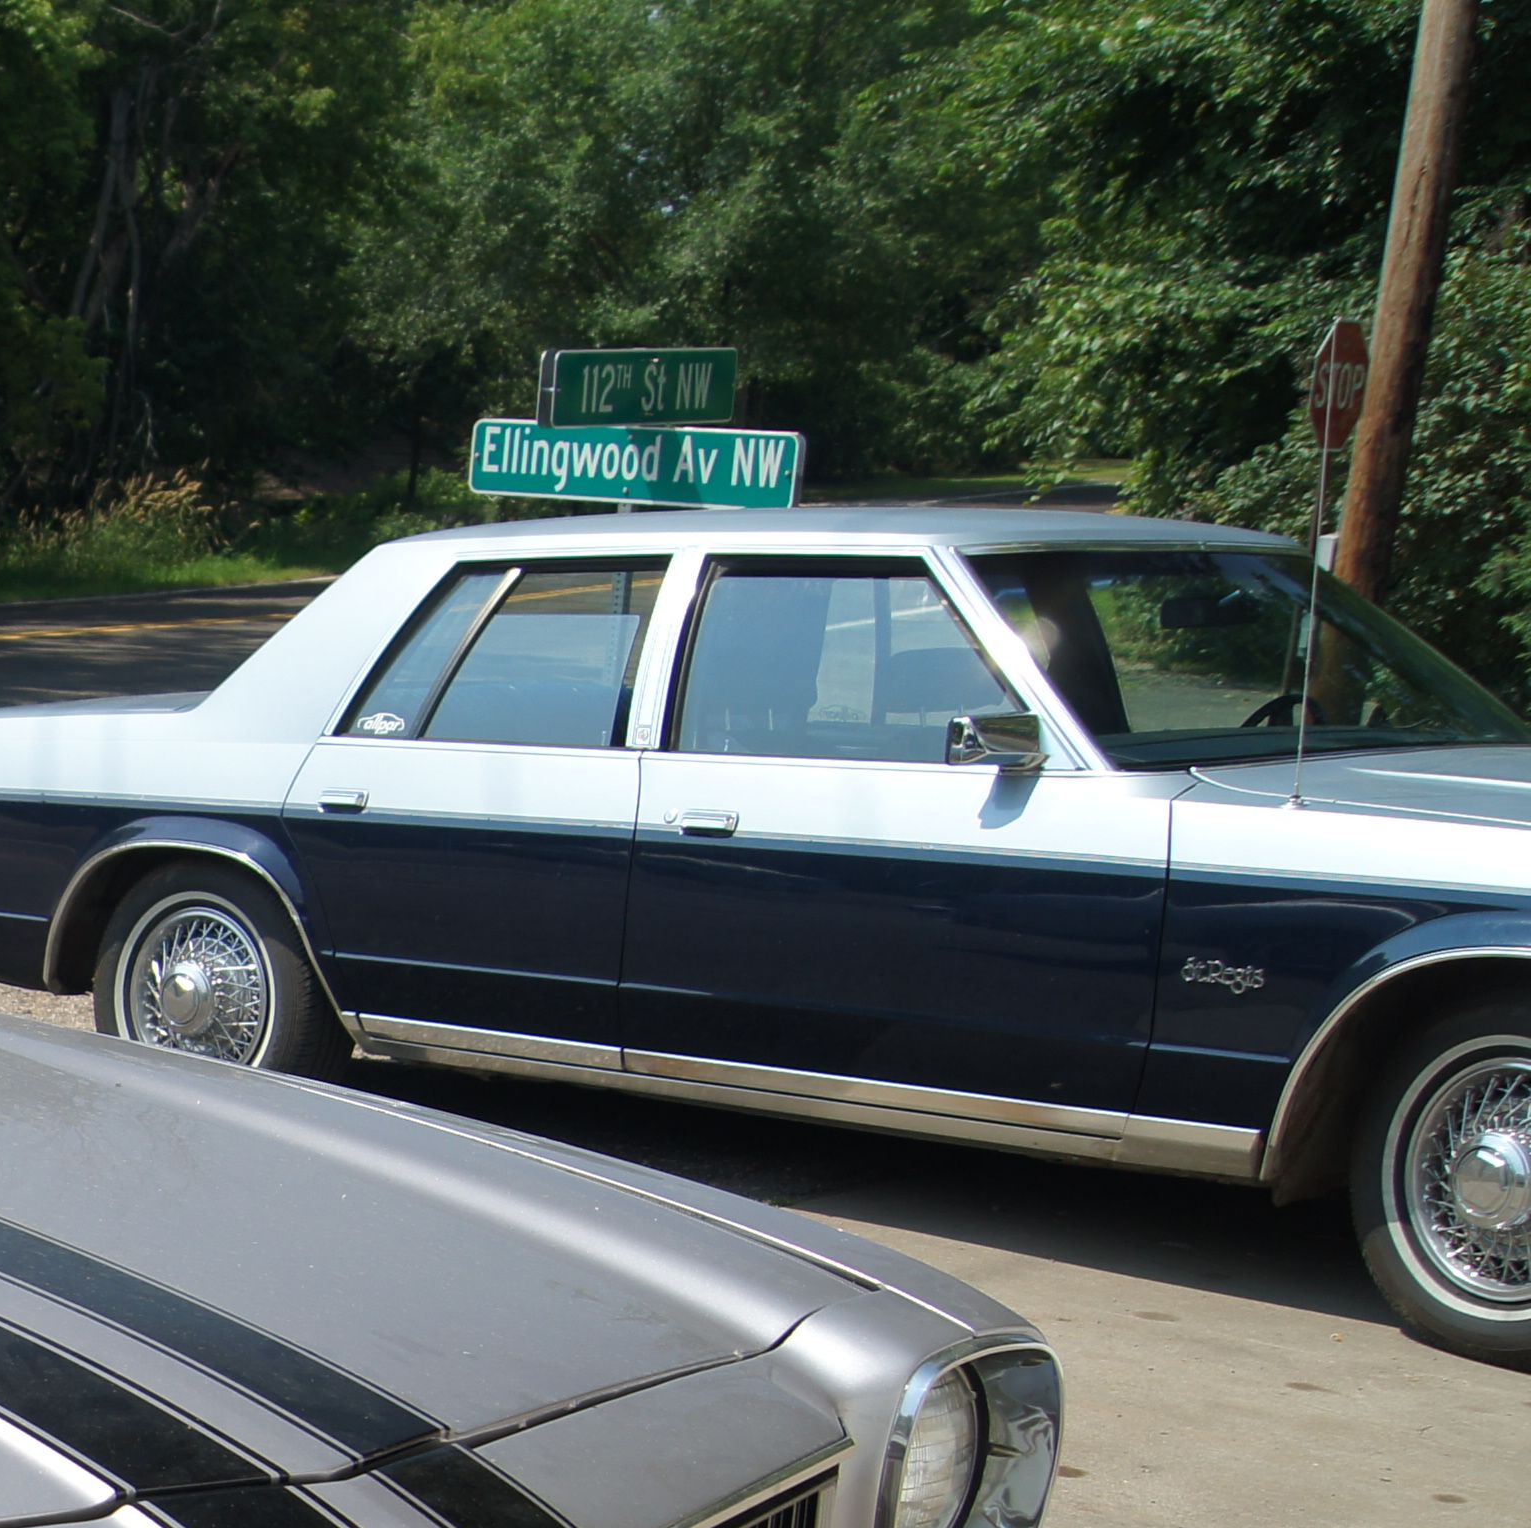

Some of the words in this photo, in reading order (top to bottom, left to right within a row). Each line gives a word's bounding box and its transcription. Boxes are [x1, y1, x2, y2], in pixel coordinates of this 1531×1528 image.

[581, 364, 632, 413] 112TH
[641, 363, 666, 411] St
[675, 362, 713, 410] NW
[1315, 362, 1365, 409] STOP
[482, 427, 662, 492] Ellingwood
[673, 435, 718, 484] Av
[731, 437, 786, 488] NW
